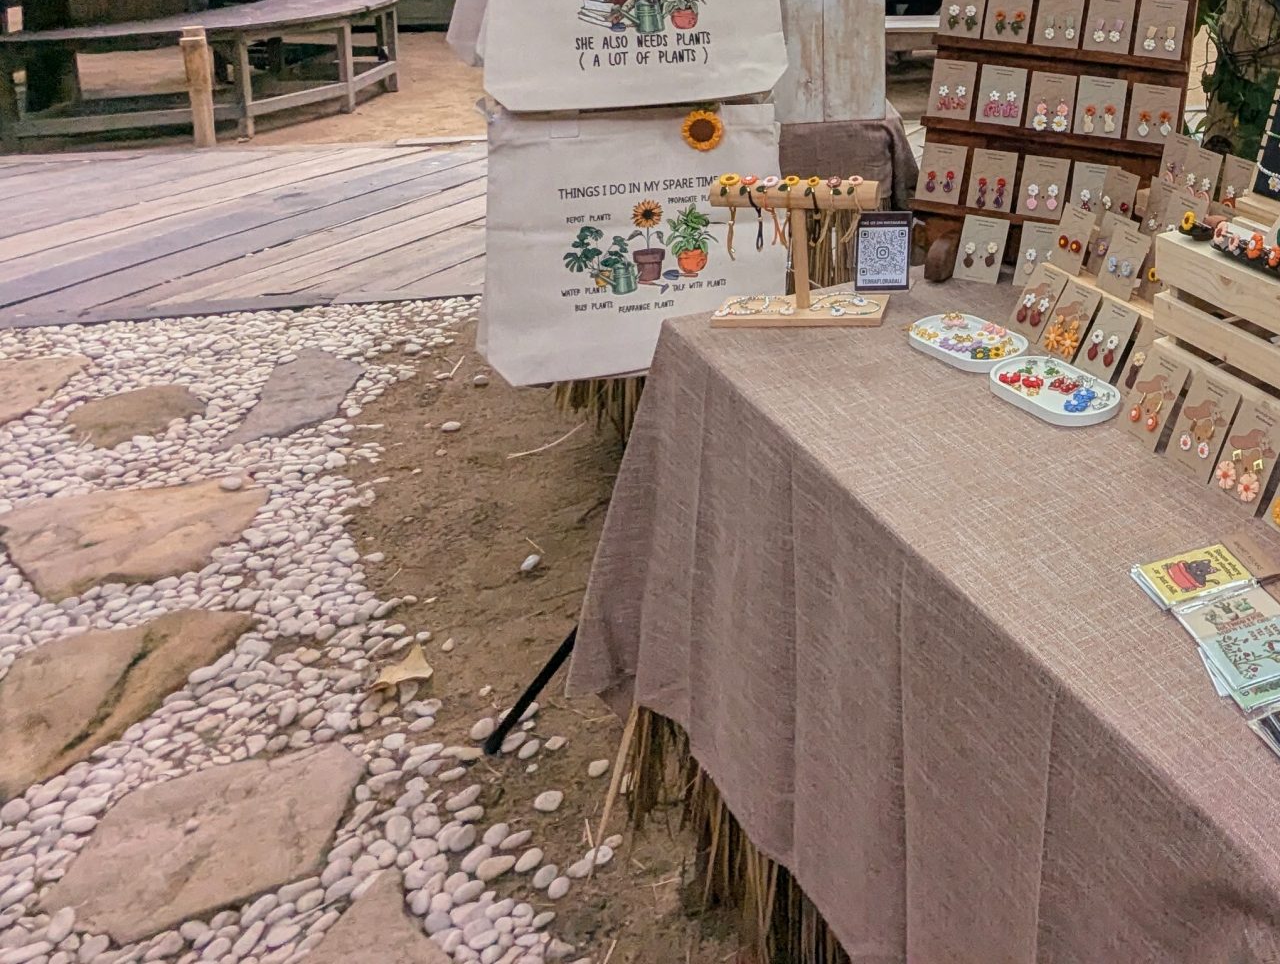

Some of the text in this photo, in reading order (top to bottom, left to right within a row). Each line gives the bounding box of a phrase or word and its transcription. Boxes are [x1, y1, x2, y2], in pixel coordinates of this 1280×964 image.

[575, 31, 711, 50] SHE ALSO NEEDS PLANTS
[593, 48, 696, 67] A LOT OF PLANTS
[558, 187, 600, 199] THINGS
[609, 184, 625, 195] DO
[629, 183, 640, 194] IN
[644, 181, 660, 192] MY
[663, 178, 693, 190] SPARE
[668, 195, 697, 204] PROPAGATE
[566, 213, 611, 223] REPOT PLANTS
[689, 281, 703, 289] WITH
[707, 279, 727, 288] PLANTS
[561, 285, 607, 297] WATER PLANTS
[592, 301, 613, 310] PLANTS
[655, 300, 674, 309] PLANTS
